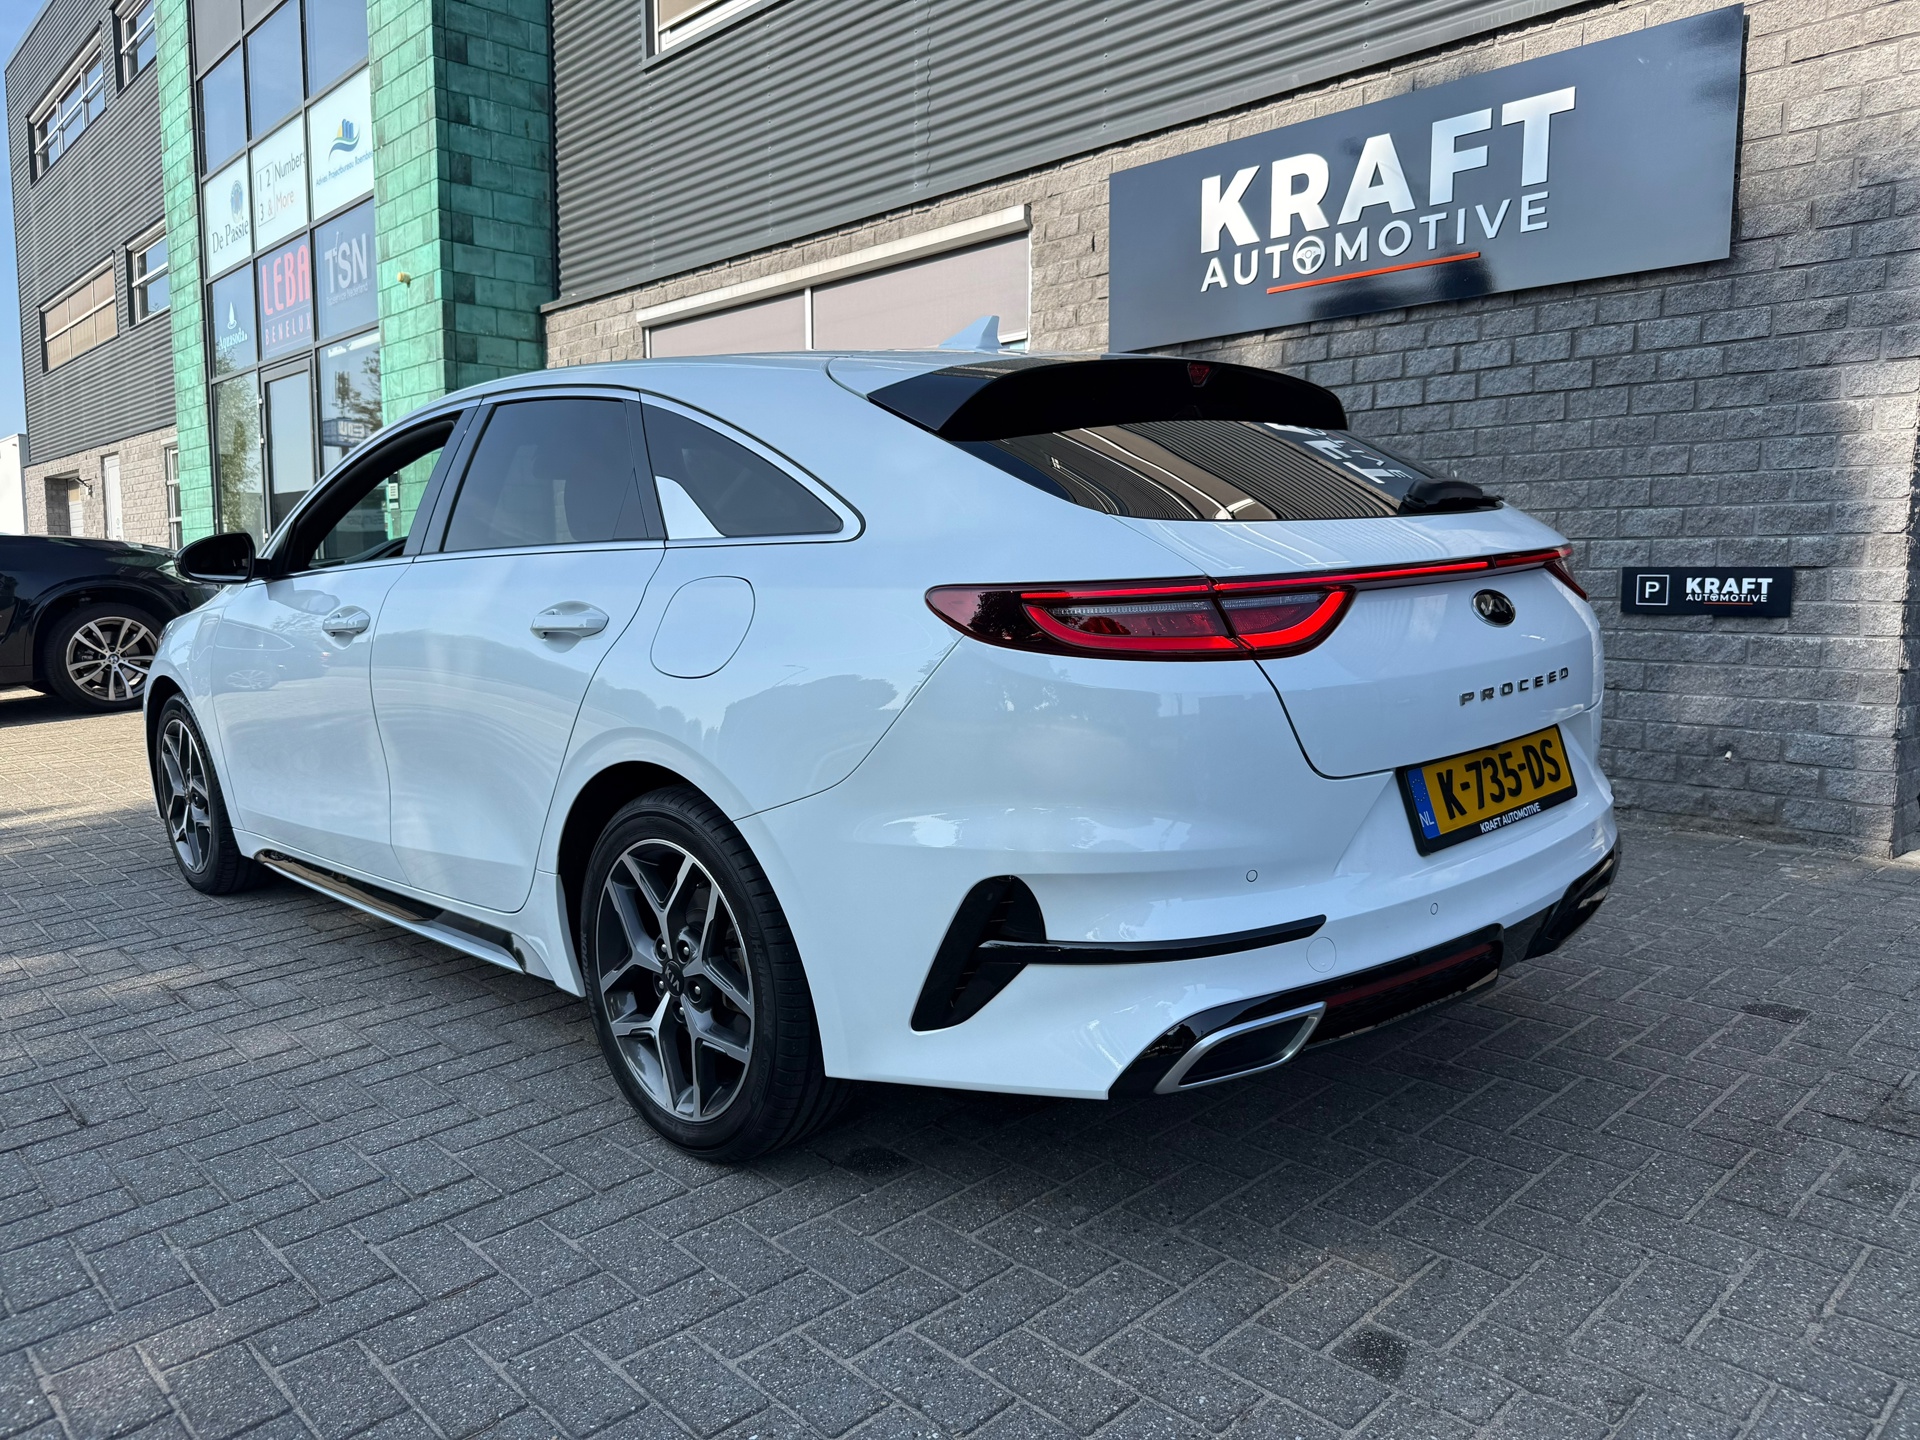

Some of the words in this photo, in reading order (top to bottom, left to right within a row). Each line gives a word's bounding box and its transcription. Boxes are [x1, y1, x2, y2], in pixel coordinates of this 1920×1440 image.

[1200, 86, 1576, 254] KRAFT
[276, 190, 295, 212] More
[211, 231, 224, 254] De
[224, 216, 249, 247] Passie
[1200, 190, 1549, 292] AUTOMOTIVE
[262, 245, 310, 316] LEBA
[324, 233, 368, 294] TSN
[265, 312, 311, 346] BENELUX
[1685, 577, 1773, 595] KRAFT
[1685, 593, 1768, 603] AUTOMOTIVE
[1459, 667, 1569, 706] PROCEED
[1437, 739, 1561, 820] K-735-DS
[1420, 811, 1435, 828] NL
[1480, 816, 1502, 833] KRAFT
[1502, 802, 1541, 826] AUTOMOTIVE
[665, 964, 680, 992] KIA
